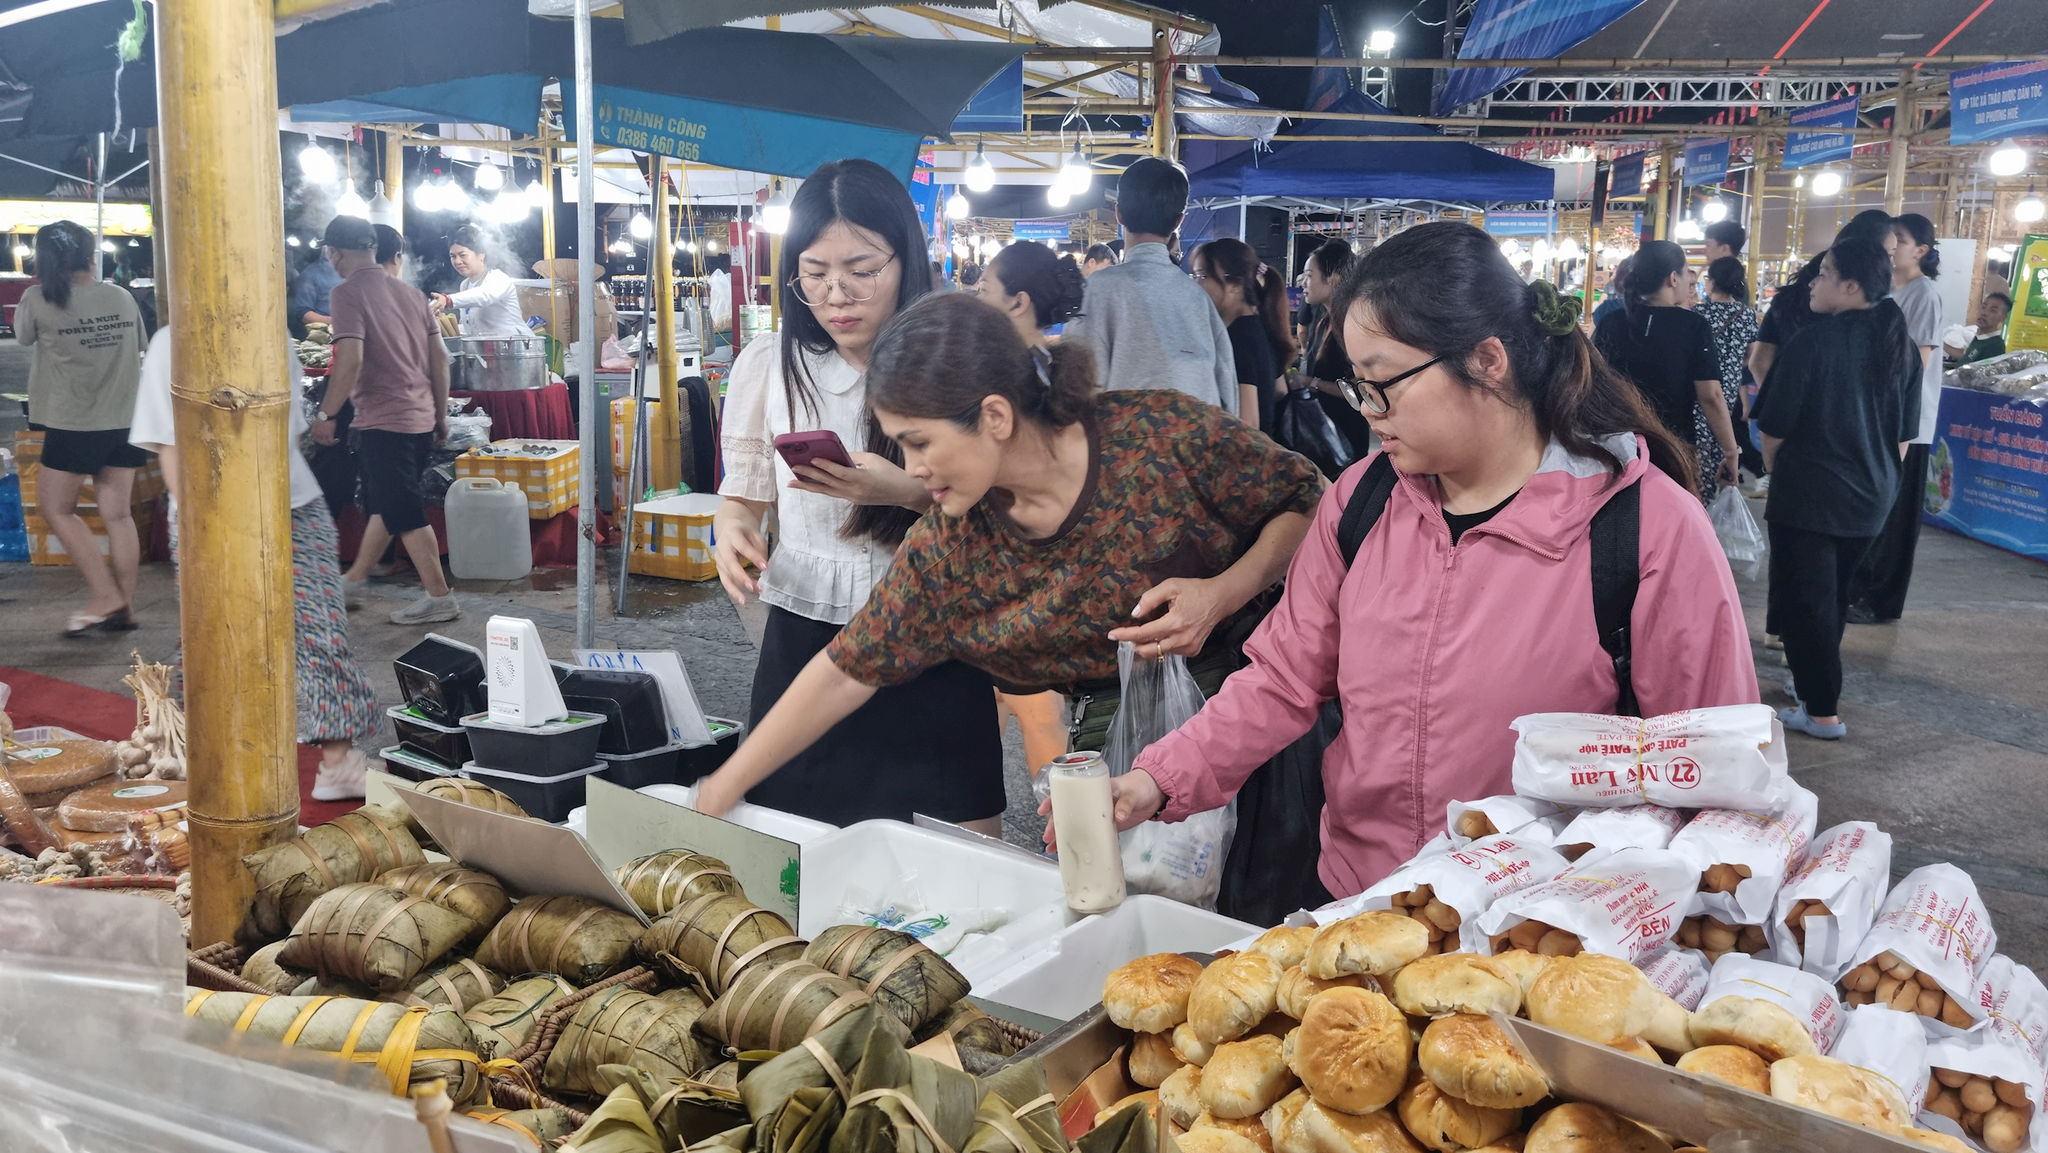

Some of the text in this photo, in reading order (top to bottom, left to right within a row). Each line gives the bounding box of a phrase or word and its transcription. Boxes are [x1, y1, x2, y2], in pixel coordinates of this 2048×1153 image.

[2030, 83, 2043, 100] TỘC
[617, 106, 707, 139] THÀNH CÔNG
[616, 127, 700, 161] 0386 460 856
[79, 314, 120, 325] LA NUIT
[57, 326, 96, 336] PORTE
[1990, 403, 2043, 428] TUẦN HÀNG
[1579, 744, 1598, 754] HỘP
[1601, 744, 1631, 756] PATÊ
[1658, 739, 1687, 752] PATÊ
[1571, 770, 1619, 787] Lan
[1672, 763, 1695, 782] 27
